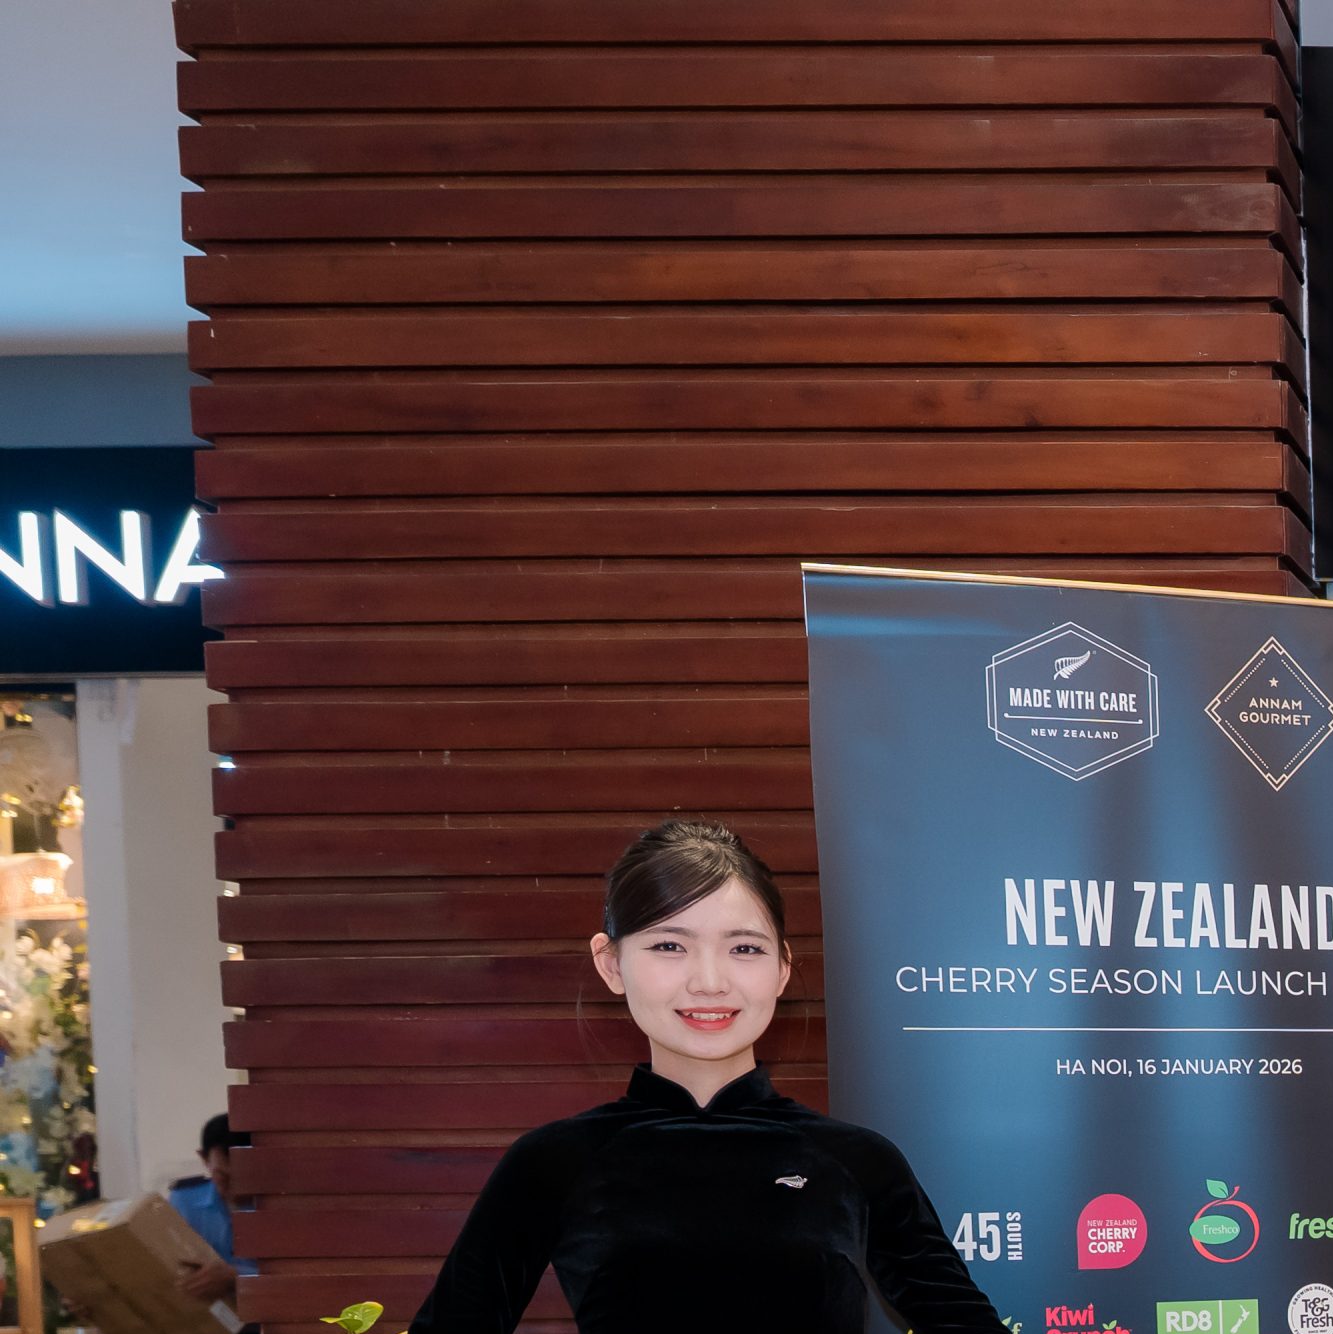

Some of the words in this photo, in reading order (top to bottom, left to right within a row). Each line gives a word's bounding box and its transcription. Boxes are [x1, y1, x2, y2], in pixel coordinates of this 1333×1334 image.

[1010, 688, 1051, 707] MADE
[1056, 690, 1094, 709] WITH
[1100, 692, 1136, 712] CARE
[1250, 698, 1301, 714] ANNAM
[1240, 712, 1311, 725] GOURMET
[1064, 730, 1118, 739] ZEALAND
[1005, 879, 1114, 946] NEW
[896, 967, 1037, 992] CHERRY
[1049, 969, 1181, 994] SEASON
[1196, 970, 1326, 995] LAUNCH
[1057, 1060, 1085, 1074] HA
[1092, 1059, 1132, 1077] NOI,
[1137, 1060, 1156, 1074] 16
[1161, 1059, 1253, 1074] JANUARY
[1259, 1059, 1302, 1074] 2026
[953, 1212, 1000, 1261] 45
[1006, 1212, 1022, 1260] SOUTH
[1088, 1228, 1137, 1242] CHERRY
[1202, 1224, 1239, 1236] Freshco
[1089, 1241, 1125, 1253] CORP.
[1046, 1303, 1094, 1326] Kiwi
[1166, 1310, 1212, 1332] RD8
[1300, 1313, 1333, 1328] Fresh
